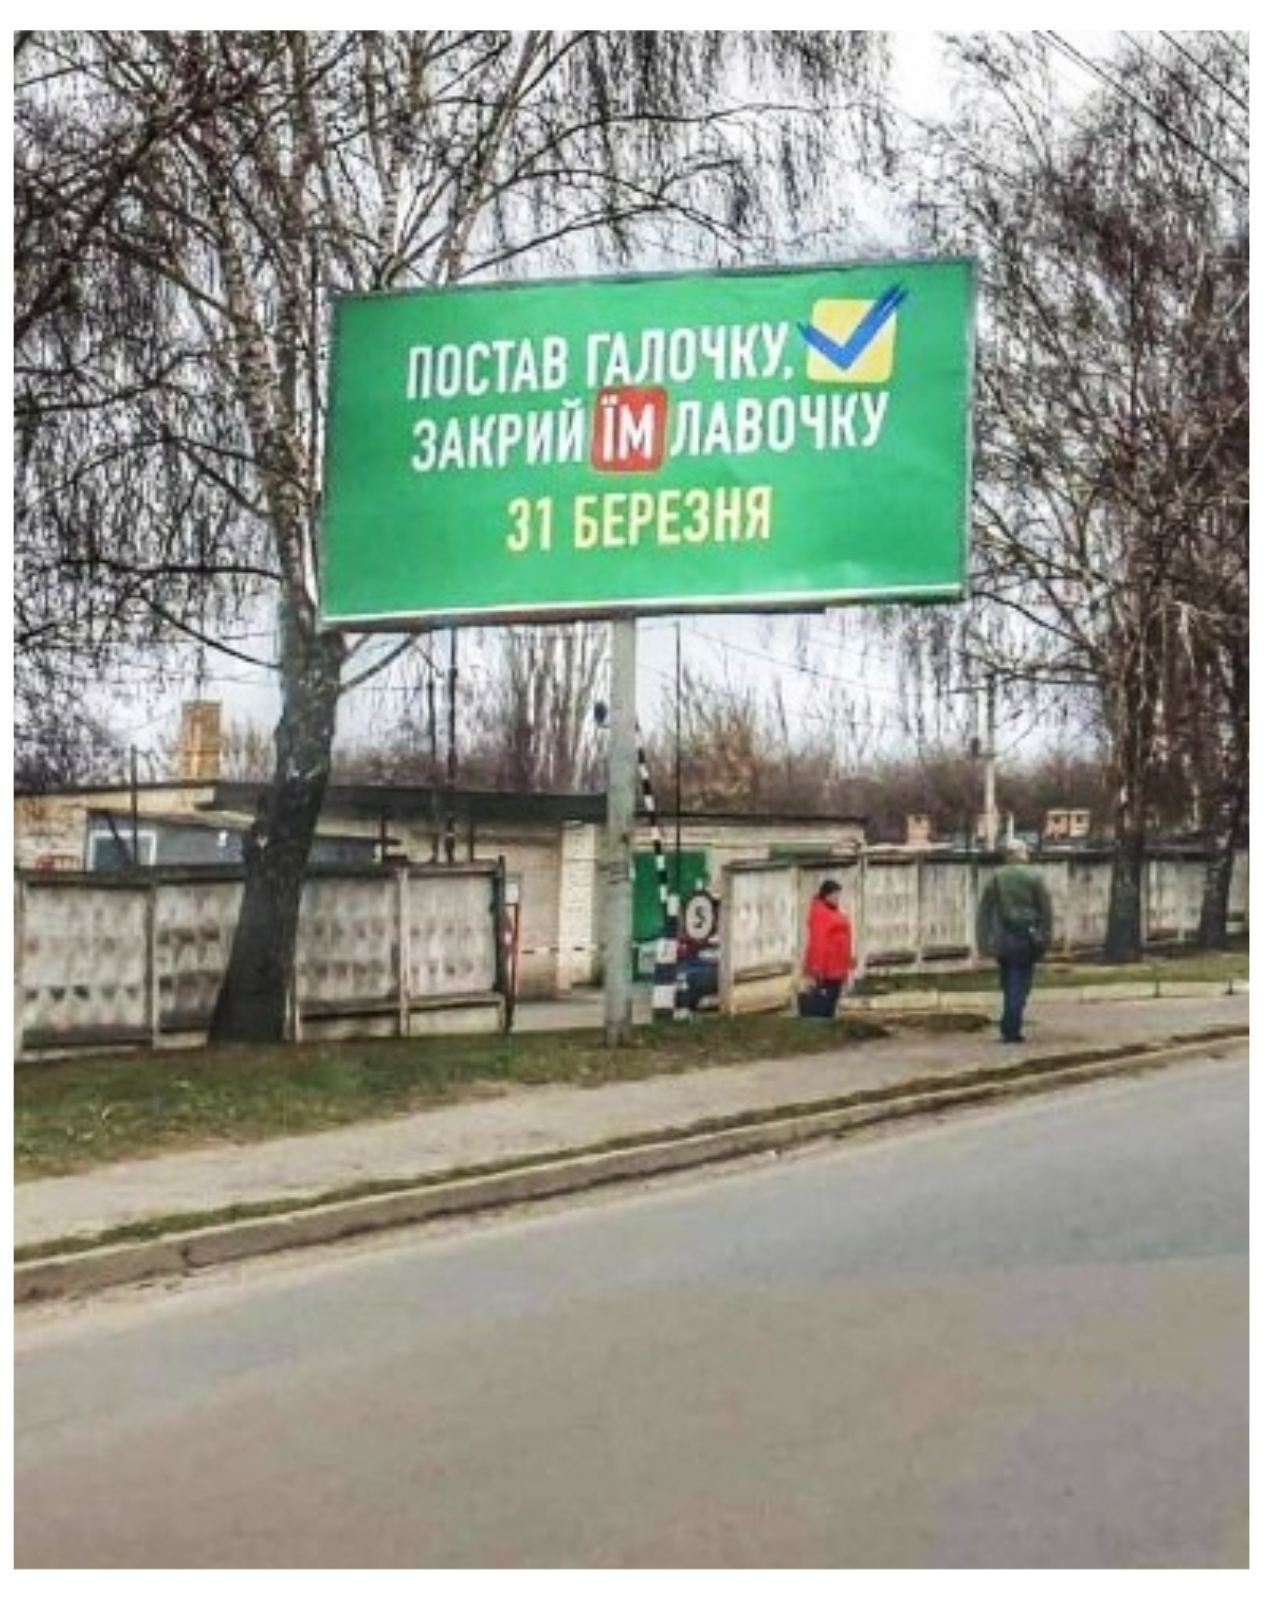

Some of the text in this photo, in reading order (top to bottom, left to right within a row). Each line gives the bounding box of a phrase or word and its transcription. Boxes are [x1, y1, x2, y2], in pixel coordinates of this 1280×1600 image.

[406, 322, 794, 400] ПОСТАВ ГАЛОЧКУ,
[411, 391, 890, 472] ЗАКРИЙ ЇМ ЛАВОЧКУ
[506, 485, 773, 552] 31 БЕРЕЗНЯ
